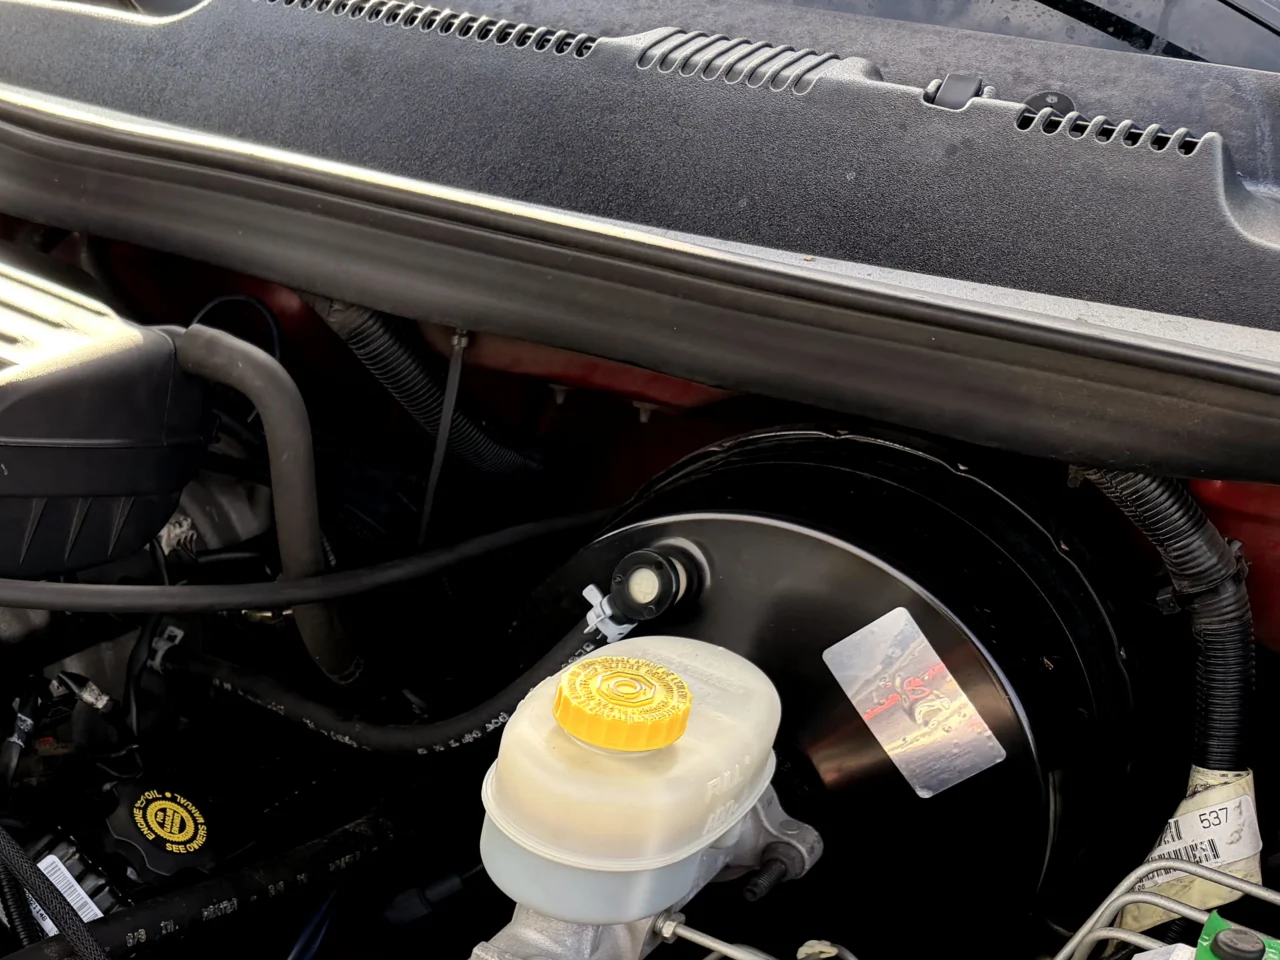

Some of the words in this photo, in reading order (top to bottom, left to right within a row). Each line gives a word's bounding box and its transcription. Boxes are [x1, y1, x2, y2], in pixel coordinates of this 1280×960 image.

[144, 789, 162, 800] OIL
[174, 793, 205, 823] MANUAL
[1199, 807, 1228, 829] 537
[133, 807, 156, 840] ENGINE
[166, 843, 187, 854] SEE
[186, 824, 207, 852] OWNERS
